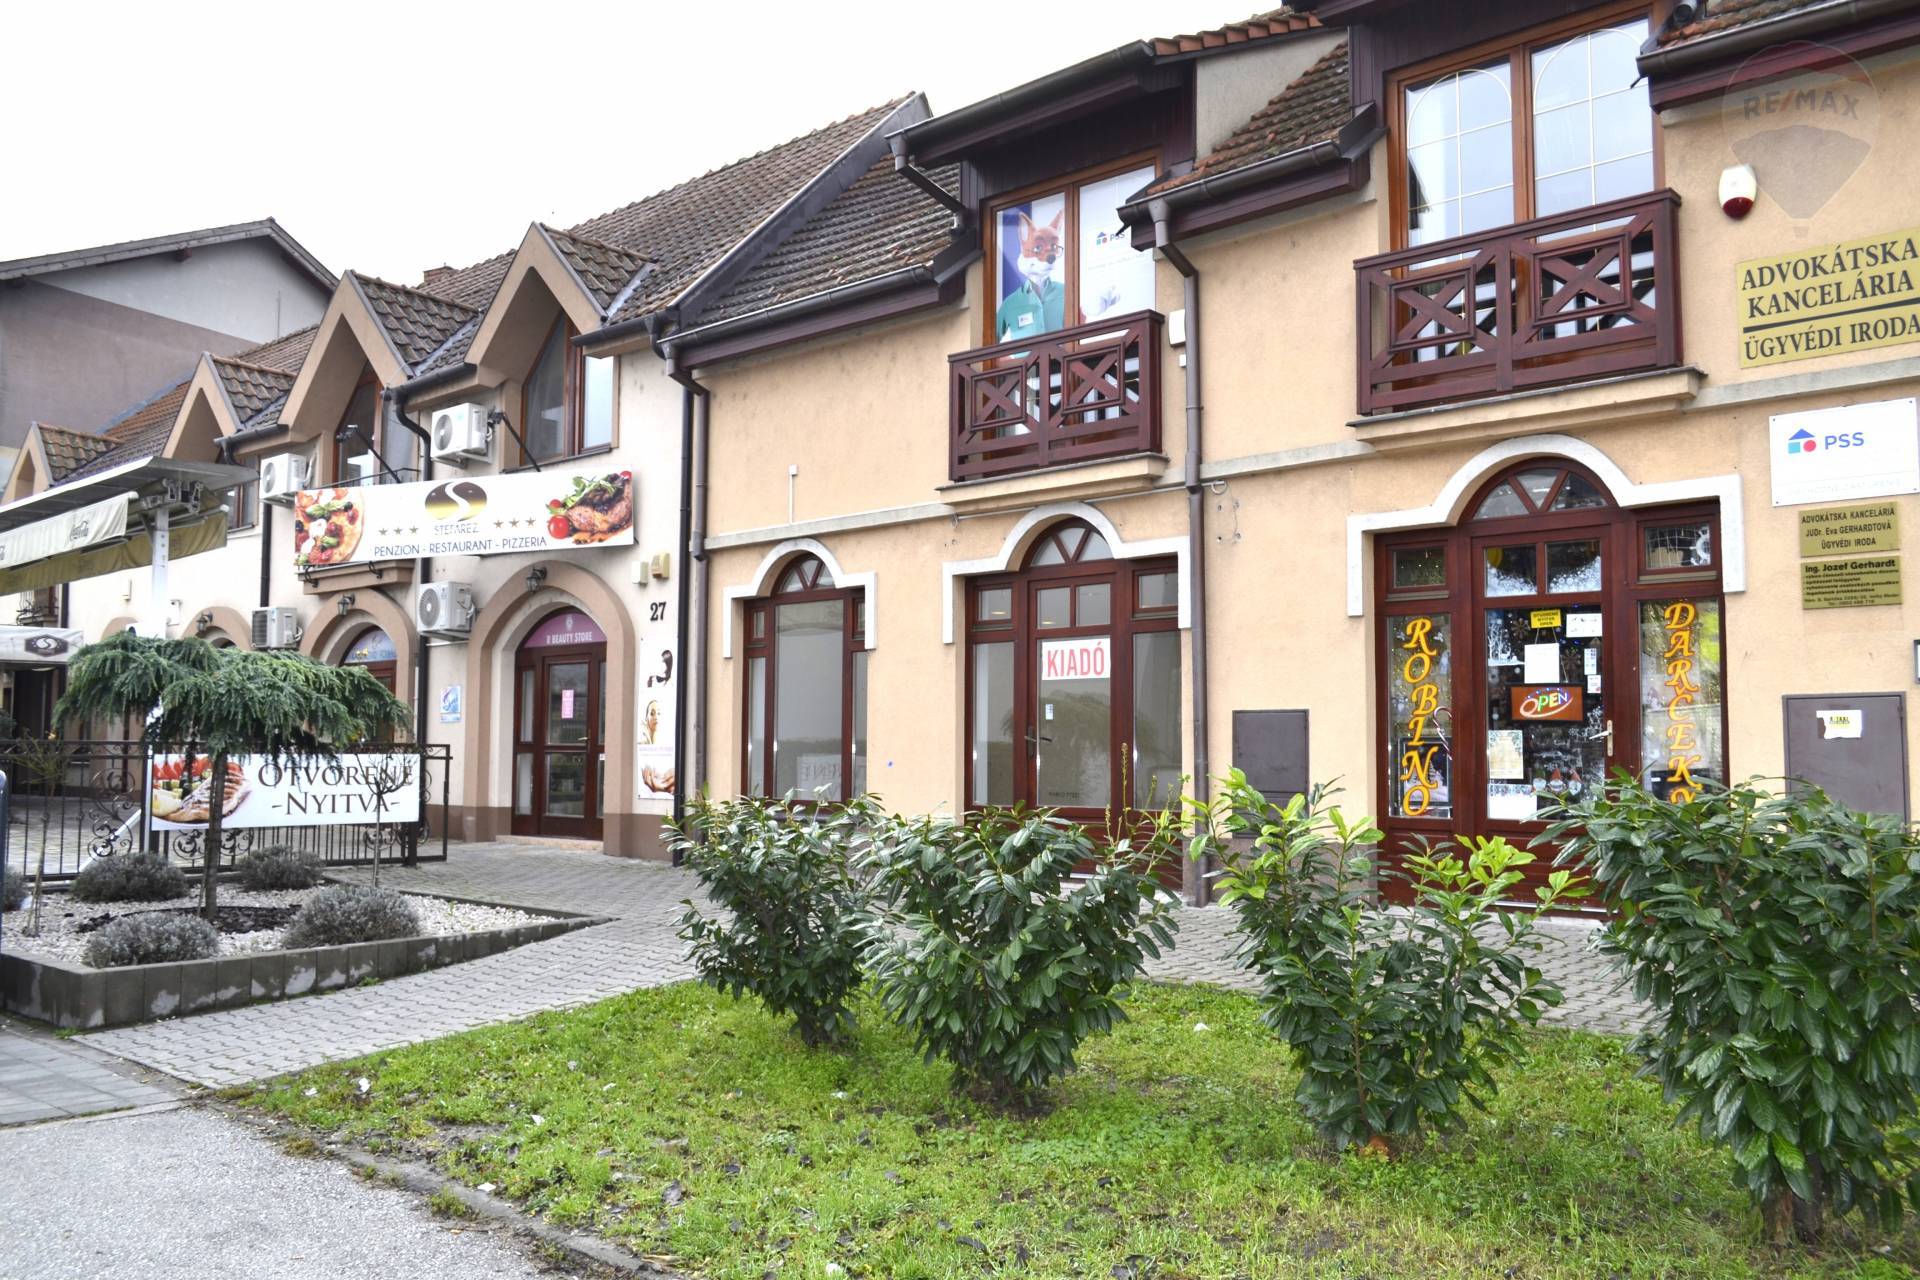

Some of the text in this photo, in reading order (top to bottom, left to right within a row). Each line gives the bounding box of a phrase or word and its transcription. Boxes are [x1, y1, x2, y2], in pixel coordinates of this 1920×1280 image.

[1742, 237, 1919, 290] ADVOKÁTSKA
[1748, 269, 1914, 319] KANCELÁRIA
[1744, 314, 1920, 361] ÜGYVÉDI IRODA
[1824, 432, 1864, 450] PSS
[1801, 506, 1895, 524] ADVOKÁTSKA KANCELÁRIA
[1826, 527, 1838, 536] Eva
[1839, 520, 1892, 534] GERHARDTOVÁ
[374, 544, 420, 557] PENZION
[429, 539, 493, 554] RESTAURANT
[502, 536, 547, 549] PIZZERIA
[1821, 537, 1877, 550] ÜGYVÉDI IRODA
[1805, 565, 1820, 574] Ing.
[1823, 562, 1848, 572] Jozef
[1850, 559, 1896, 570] Gerhardt
[650, 601, 667, 621] 27
[552, 633, 573, 645] BEAUTY
[574, 631, 593, 642] STORE
[1047, 642, 1105, 677] KIADÓ
[1520, 692, 1568, 716] OPEN
[1399, 617, 1438, 817] ROBINO
